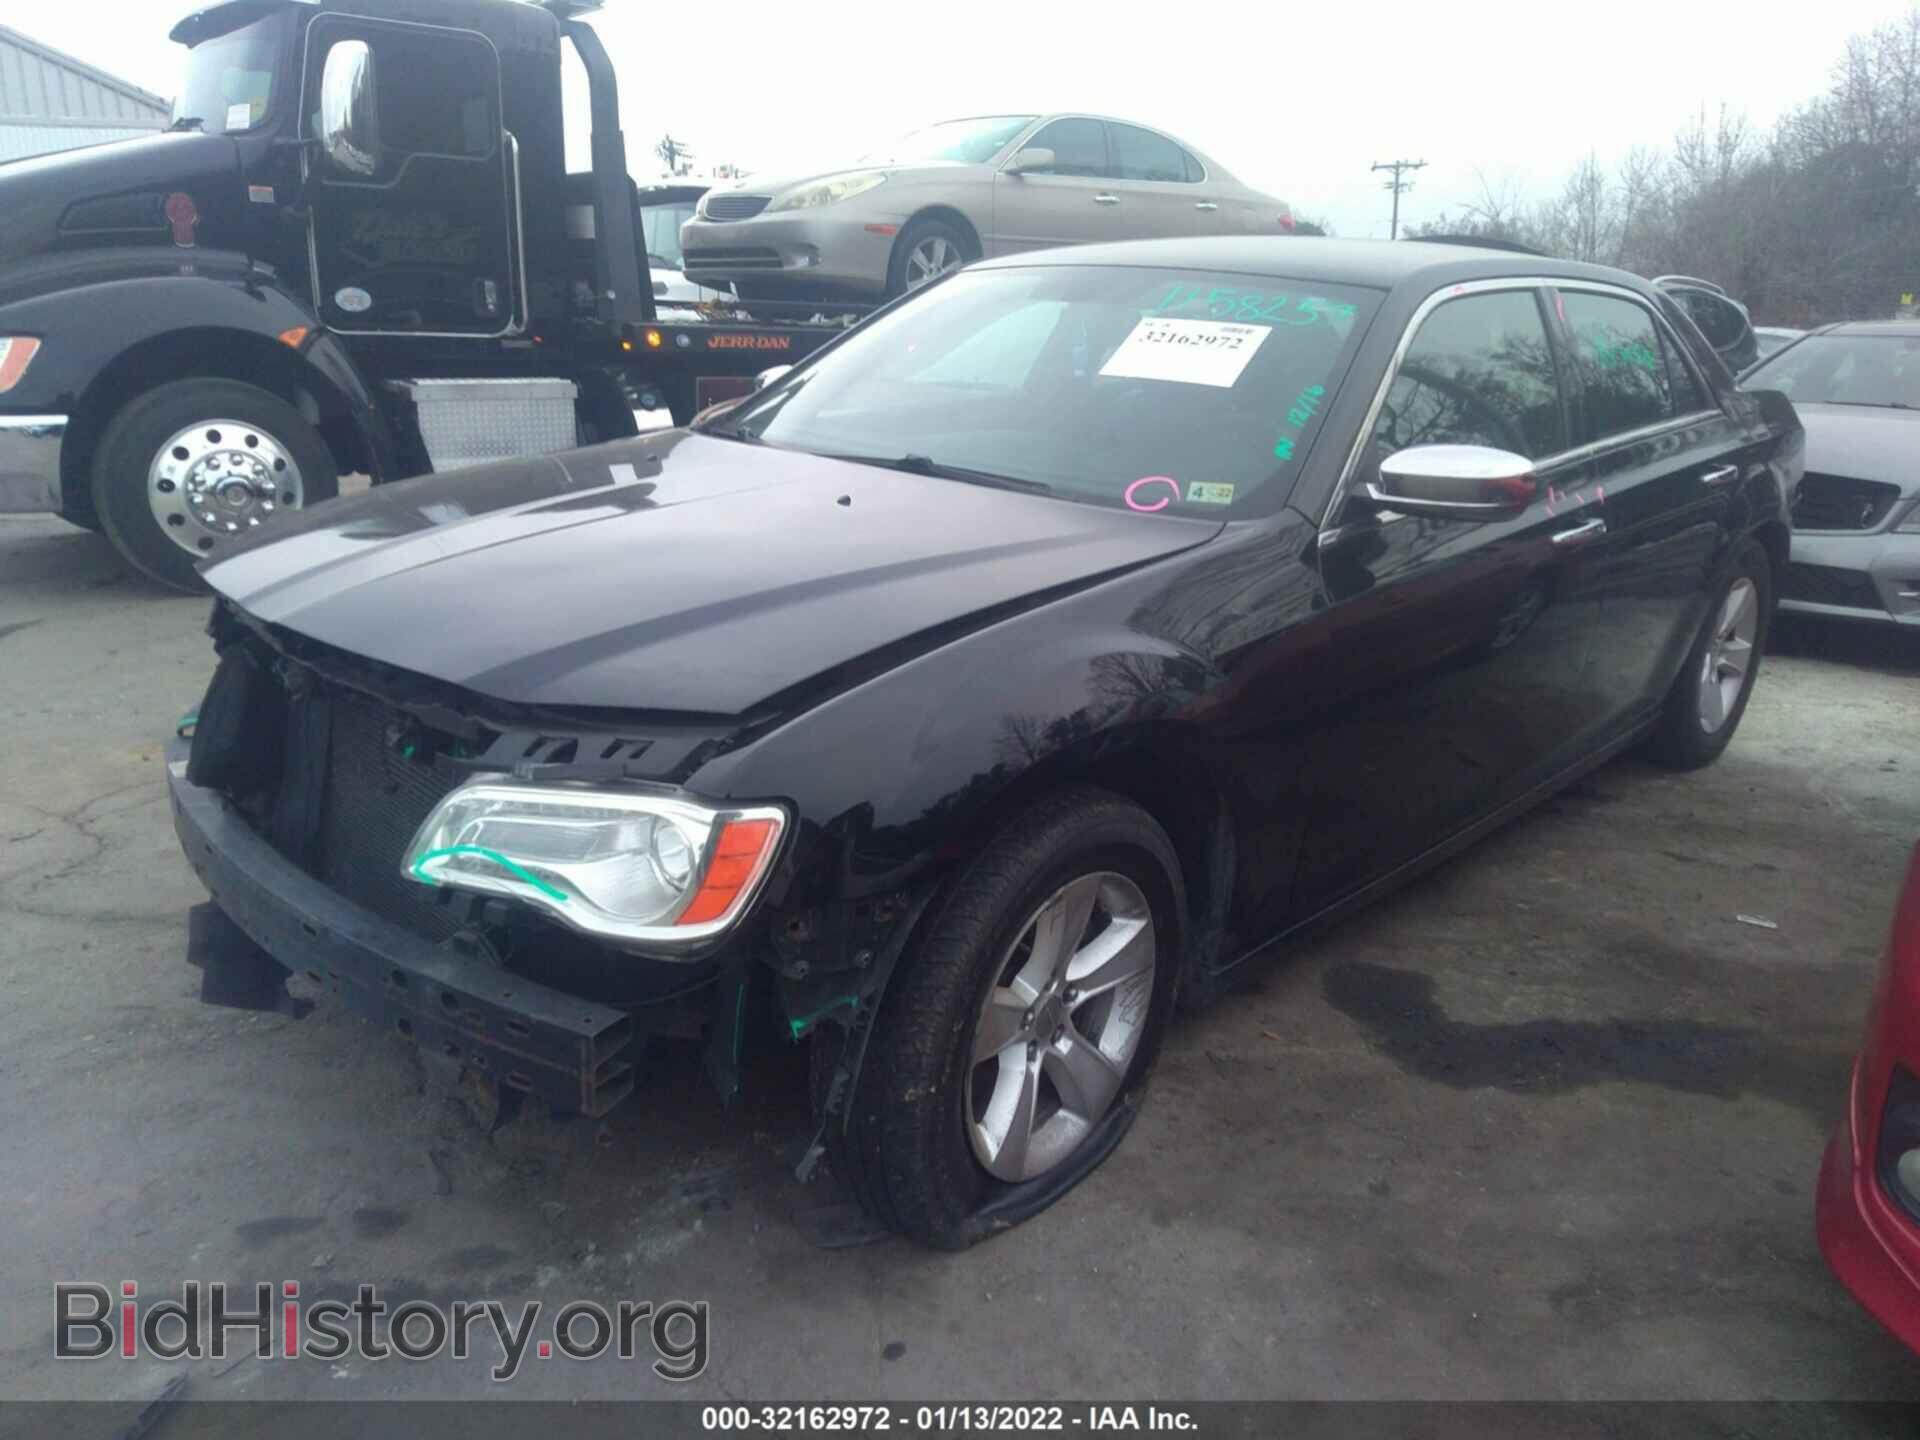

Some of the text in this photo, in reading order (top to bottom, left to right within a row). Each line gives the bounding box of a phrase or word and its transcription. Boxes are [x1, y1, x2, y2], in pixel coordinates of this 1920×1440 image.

[707, 335, 790, 349] JERR DAN
[1139, 331, 1244, 350] 32162972
[1191, 486, 1203, 498] 4
